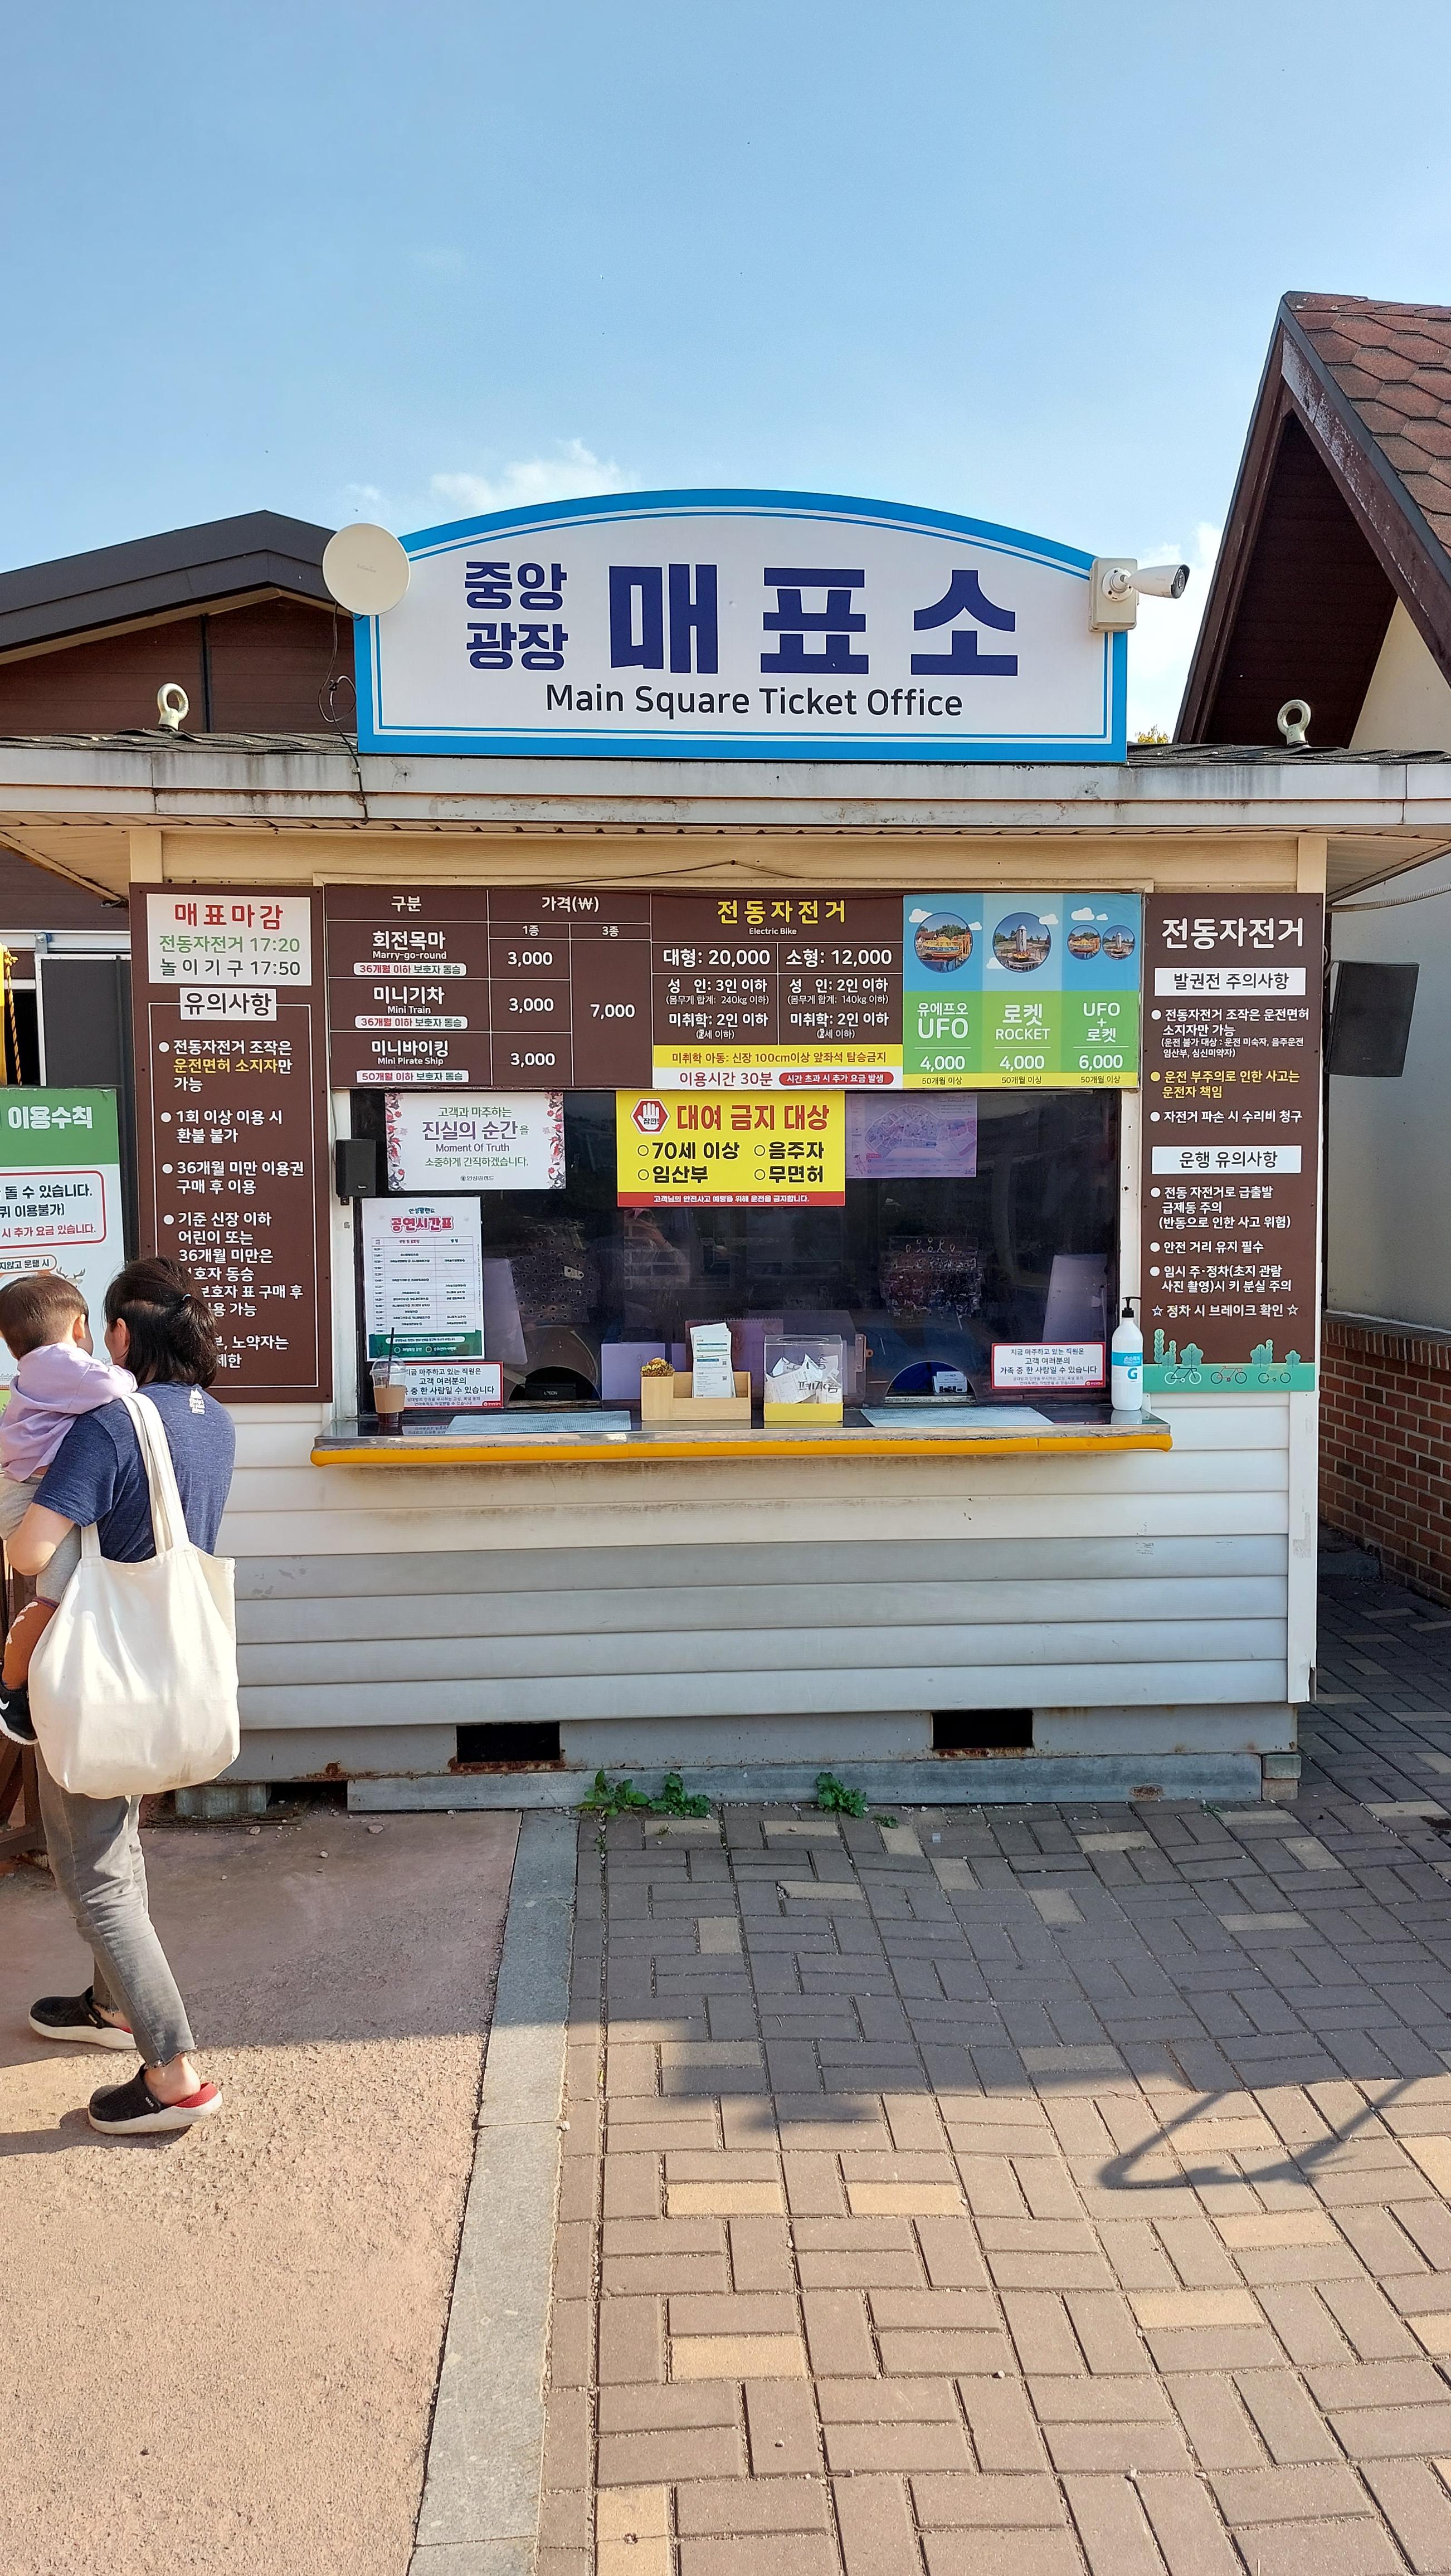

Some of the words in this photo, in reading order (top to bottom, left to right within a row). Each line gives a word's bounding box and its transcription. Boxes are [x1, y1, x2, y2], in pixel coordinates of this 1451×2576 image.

[465, 561, 566, 609] 중앙
[610, 564, 1018, 676] 매표소
[466, 622, 566, 670] 광장
[546, 683, 624, 713] Main
[635, 686, 748, 719] Square
[760, 687, 858, 716] Ticket
[867, 688, 963, 718] Office
[392, 896, 421, 912] 구분
[175, 903, 283, 929] 매표마감
[717, 900, 845, 925] 전동자전거
[522, 925, 539, 936] 1종
[602, 926, 620, 936] 3종
[1162, 918, 1303, 949] 전동자전거
[159, 935, 243, 954] 전동자전거
[250, 938, 300, 952] 17:20
[373, 930, 445, 950] 회전목마
[373, 950, 446, 960] Marry-go-round
[508, 952, 553, 967] 3,000
[663, 949, 703, 968] 대형:
[709, 950, 770, 968] 20,000
[785, 949, 825, 968] 소형:
[831, 949, 892, 967] 12,000
[251, 961, 300, 975] 17:50
[360, 965, 390, 973] 36개월
[394, 965, 410, 973] 이하
[413, 965, 440, 973] 보호자
[444, 965, 460, 974] 동승
[1174, 973, 1220, 990] 발권전
[1226, 973, 1289, 989] 주의사항
[374, 986, 445, 1004] 미니기차
[184, 993, 272, 1016] 유의사항
[388, 1006, 406, 1014] Mini
[408, 1006, 431, 1014] Train
[509, 998, 554, 1013] 3,000
[590, 1004, 635, 1019] 7,000
[917, 1002, 968, 1017] 유에프오
[1083, 1002, 1120, 1017] UFO
[669, 1012, 713, 1027] 미취학:
[717, 1012, 738, 1027] 2인
[742, 1012, 768, 1026] 이하
[1002, 1003, 1043, 1026] 로켓
[918, 1018, 968, 1039] UFO
[996, 1028, 1050, 1040] ROCKET
[1086, 1028, 1116, 1043] 로켓
[173, 1040, 245, 1055] 전동자전거
[249, 1041, 292, 1055] 조작은
[372, 1040, 449, 1057] 미니바이킹
[425, 1057, 444, 1066] Ship
[510, 1053, 556, 1067] 3,000
[672, 1052, 702, 1063] 미취학
[706, 1052, 728, 1063] 아동:
[733, 1052, 751, 1063] 신장
[755, 1052, 810, 1063] 100cm이상
[814, 1051, 843, 1063] 앞좌석
[846, 1051, 886, 1063] 탑승금지
[920, 1056, 965, 1071] 4,000
[1000, 1056, 1045, 1072] 4,000
[1079, 1055, 1123, 1071] 6,000
[173, 1058, 230, 1073] 운전면허
[236, 1059, 293, 1074] 소지자만
[362, 1072, 393, 1081] 50개월
[396, 1072, 413, 1081] 이하
[416, 1072, 443, 1081] 보호자
[446, 1072, 462, 1081] 동승
[680, 1071, 736, 1087] 이용시간
[740, 1071, 773, 1087] 30분
[787, 1074, 802, 1083] 시간
[805, 1074, 820, 1083] 초과
[822, 1074, 830, 1083] 시
[832, 1074, 848, 1083] 추가
[850, 1074, 866, 1083] 요금
[868, 1074, 884, 1083] 발생
[922, 1076, 946, 1085] 50개월
[948, 1076, 962, 1085] 이상
[1080, 1075, 1104, 1084] 50개월
[1106, 1075, 1121, 1084] 이상
[1165, 1071, 1187, 1083] 운전
[1191, 1071, 1237, 1083] 부주의로
[1240, 1071, 1262, 1083] 인한
[1266, 1070, 1300, 1083] 사고는
[174, 1077, 203, 1092] 가능
[1162, 1086, 1196, 1099] 운전자
[1200, 1086, 1222, 1099] 책임
[8, 1106, 92, 1129] 이용수칙
[176, 1110, 199, 1124] 1회
[204, 1110, 232, 1125] 이상
[237, 1110, 265, 1125] 이용
[270, 1110, 283, 1124] 시
[439, 1107, 469, 1118] 고객과
[471, 1106, 512, 1118] 마주하는
[677, 1105, 721, 1130] 대여
[731, 1105, 774, 1130] 금지
[784, 1105, 829, 1130] 대상
[177, 1129, 205, 1144] 환불
[210, 1129, 238, 1144] 불가
[422, 1121, 476, 1140] 진실의
[436, 1144, 471, 1152] Moment
[474, 1144, 484, 1152] Of
[486, 1143, 509, 1152] Truth
[652, 1141, 697, 1160] 70세
[703, 1141, 740, 1160] 이상
[768, 1141, 824, 1160] 음주자
[425, 1157, 461, 1167] 소중하게
[464, 1157, 528, 1167] 간직하겠습니다.
[1179, 1152, 1210, 1168] 운행
[1215, 1151, 1278, 1168] 유의사항
[177, 1161, 225, 1176] 36개월
[230, 1161, 257, 1176] 미만
[262, 1161, 304, 1176] 이용권
[653, 1165, 708, 1184] 임산부
[768, 1165, 824, 1183] 무면허
[177, 1179, 205, 1194] 구매
[210, 1179, 223, 1194] 후
[228, 1179, 256, 1194] 이용
[735, 1195, 749, 1203] 위해
[178, 1212, 207, 1227] 기준
[211, 1212, 238, 1227] 신장
[244, 1212, 271, 1227] 이하
[392, 1217, 453, 1231] 공연시간표
[2, 1228, 11, 1238] 시
[14, 1227, 33, 1237] 추가
[36, 1226, 54, 1236] 요금
[57, 1224, 96, 1235] 있습니다.
[178, 1230, 220, 1245] 어린이
[226, 1230, 253, 1245] 또는
[179, 1248, 226, 1264] 36개월
[231, 1248, 273, 1264] 미만은
[1167, 1305, 1191, 1318] 정차
[1194, 1305, 1205, 1318] 시
[1209, 1305, 1257, 1318] 브레이크
[1260, 1304, 1283, 1317] 확인
